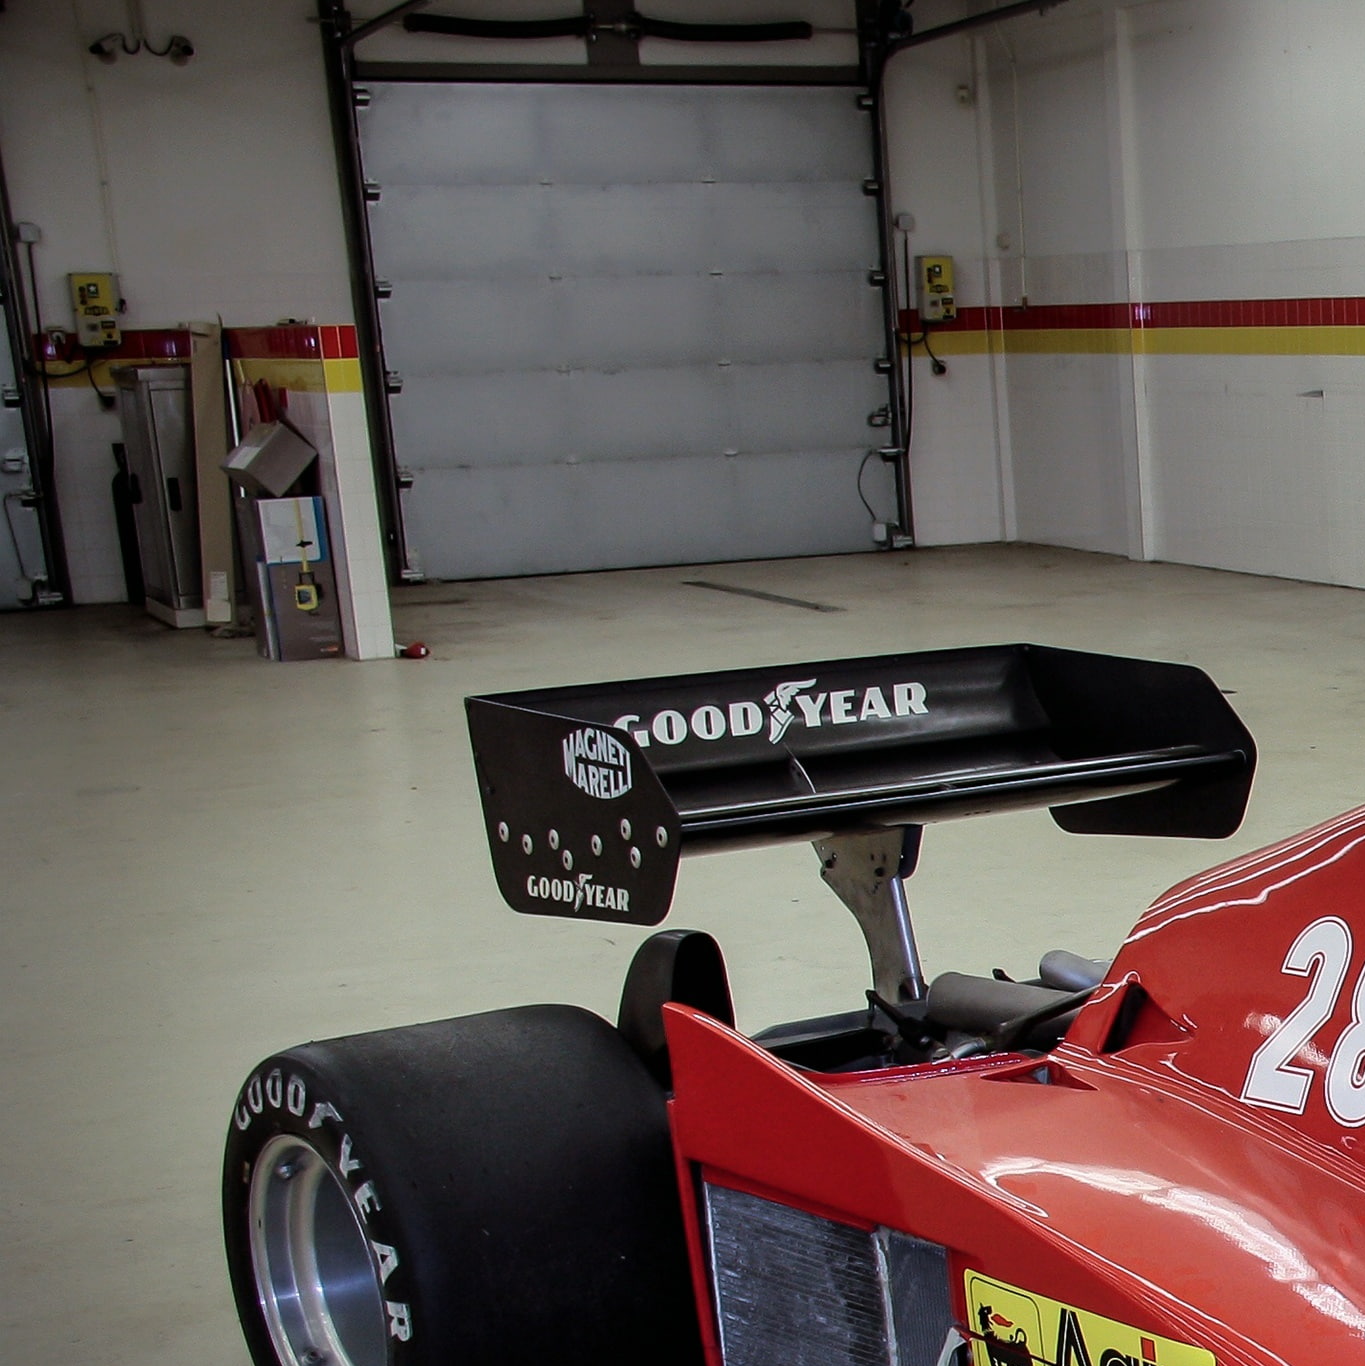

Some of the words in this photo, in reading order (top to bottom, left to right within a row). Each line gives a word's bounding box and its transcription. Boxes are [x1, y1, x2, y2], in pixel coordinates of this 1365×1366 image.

[796, 682, 928, 727] YEAR
[562, 727, 632, 774] MAGNETI
[564, 757, 633, 799] MARELLI
[584, 884, 630, 912] YEAR
